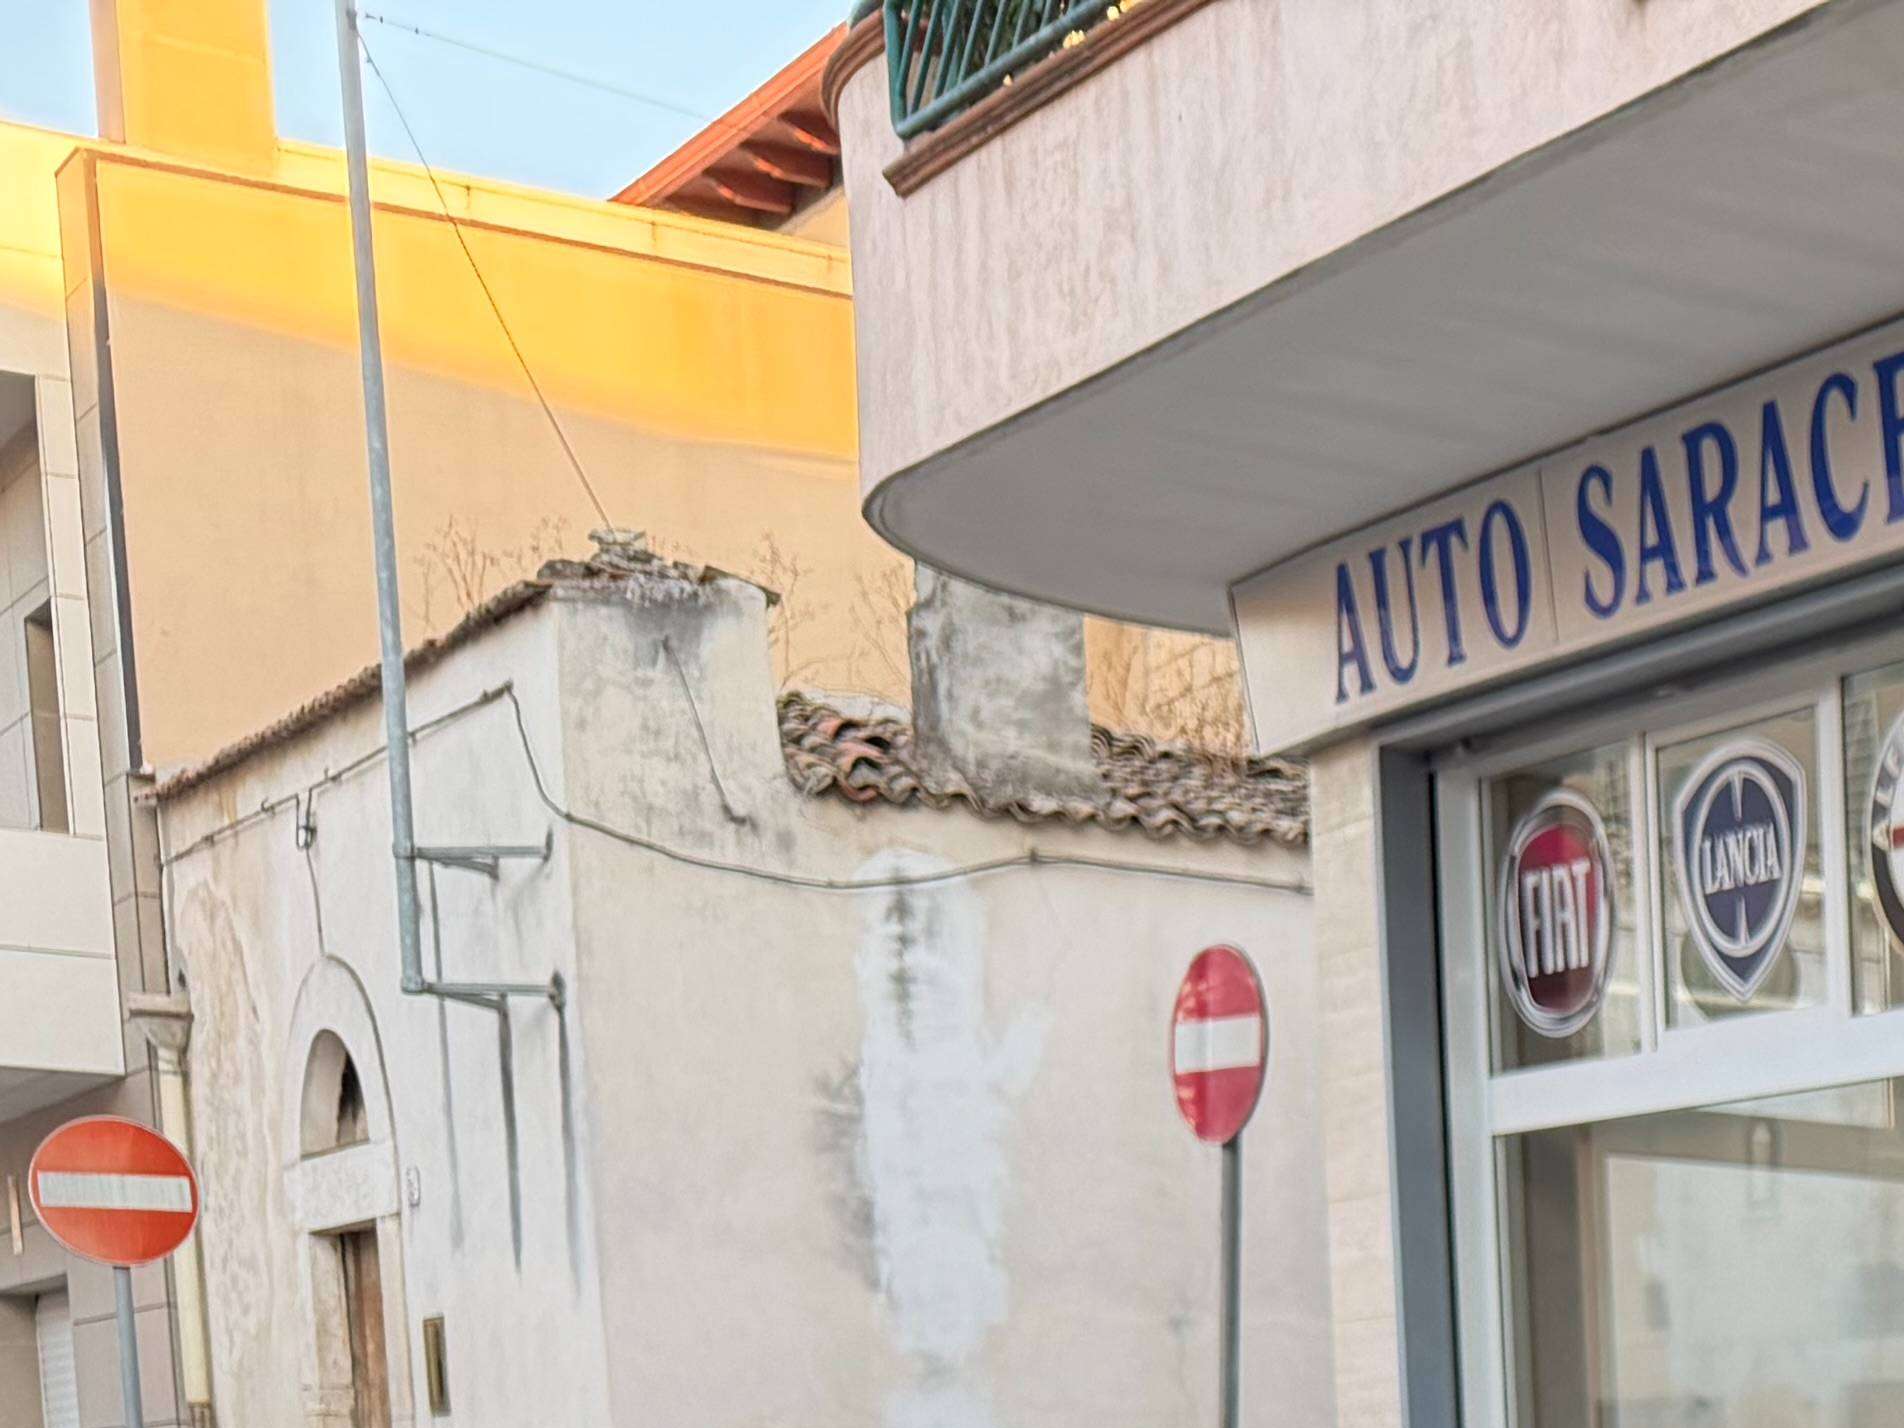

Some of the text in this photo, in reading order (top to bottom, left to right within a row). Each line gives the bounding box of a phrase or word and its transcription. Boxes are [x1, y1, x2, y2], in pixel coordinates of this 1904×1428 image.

[1335, 499, 1534, 704] AUTO
[1702, 821, 1780, 895] LANCIA
[1521, 860, 1592, 979] FIAT
